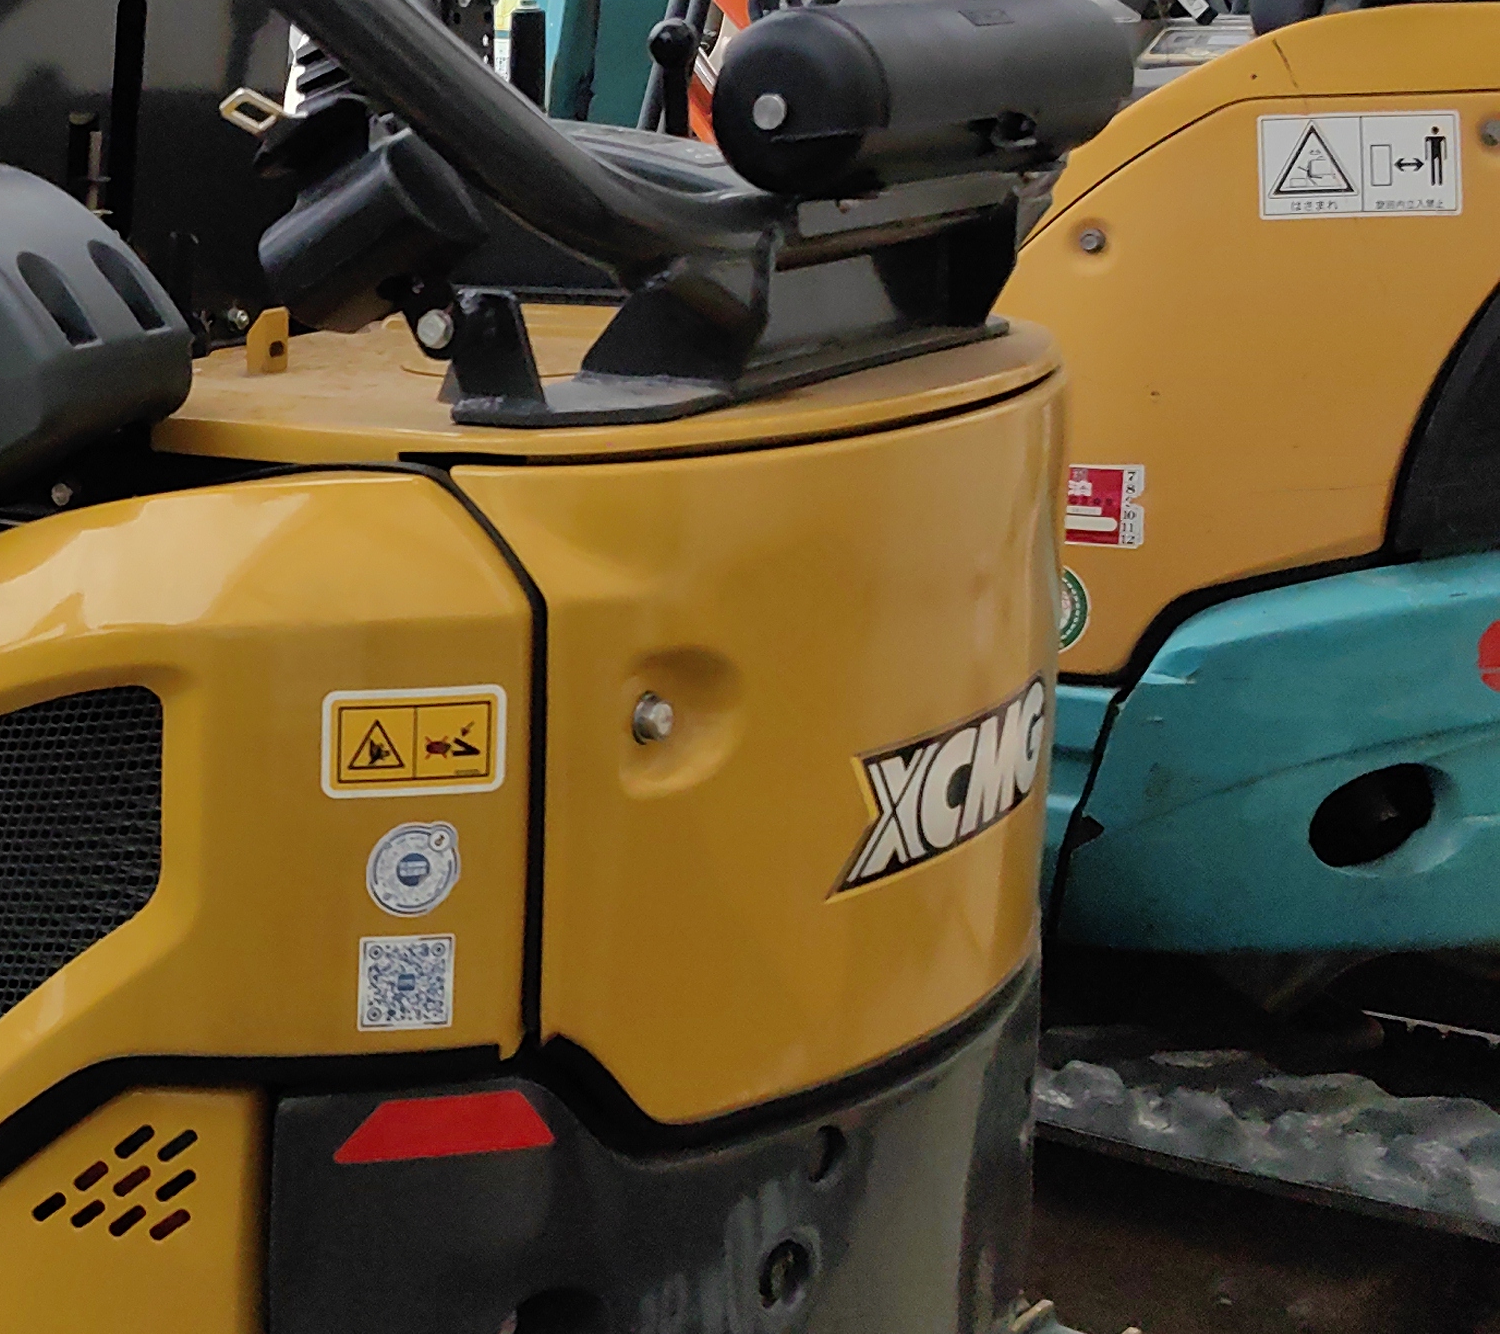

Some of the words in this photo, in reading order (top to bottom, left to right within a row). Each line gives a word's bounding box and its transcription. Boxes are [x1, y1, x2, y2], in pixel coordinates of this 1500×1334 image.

[1127, 471, 1136, 481] 7
[1126, 485, 1136, 495] 8
[1123, 510, 1136, 520] 10
[1122, 523, 1134, 532] 11
[1121, 535, 1135, 544] 12
[846, 681, 1045, 882] XCMG
